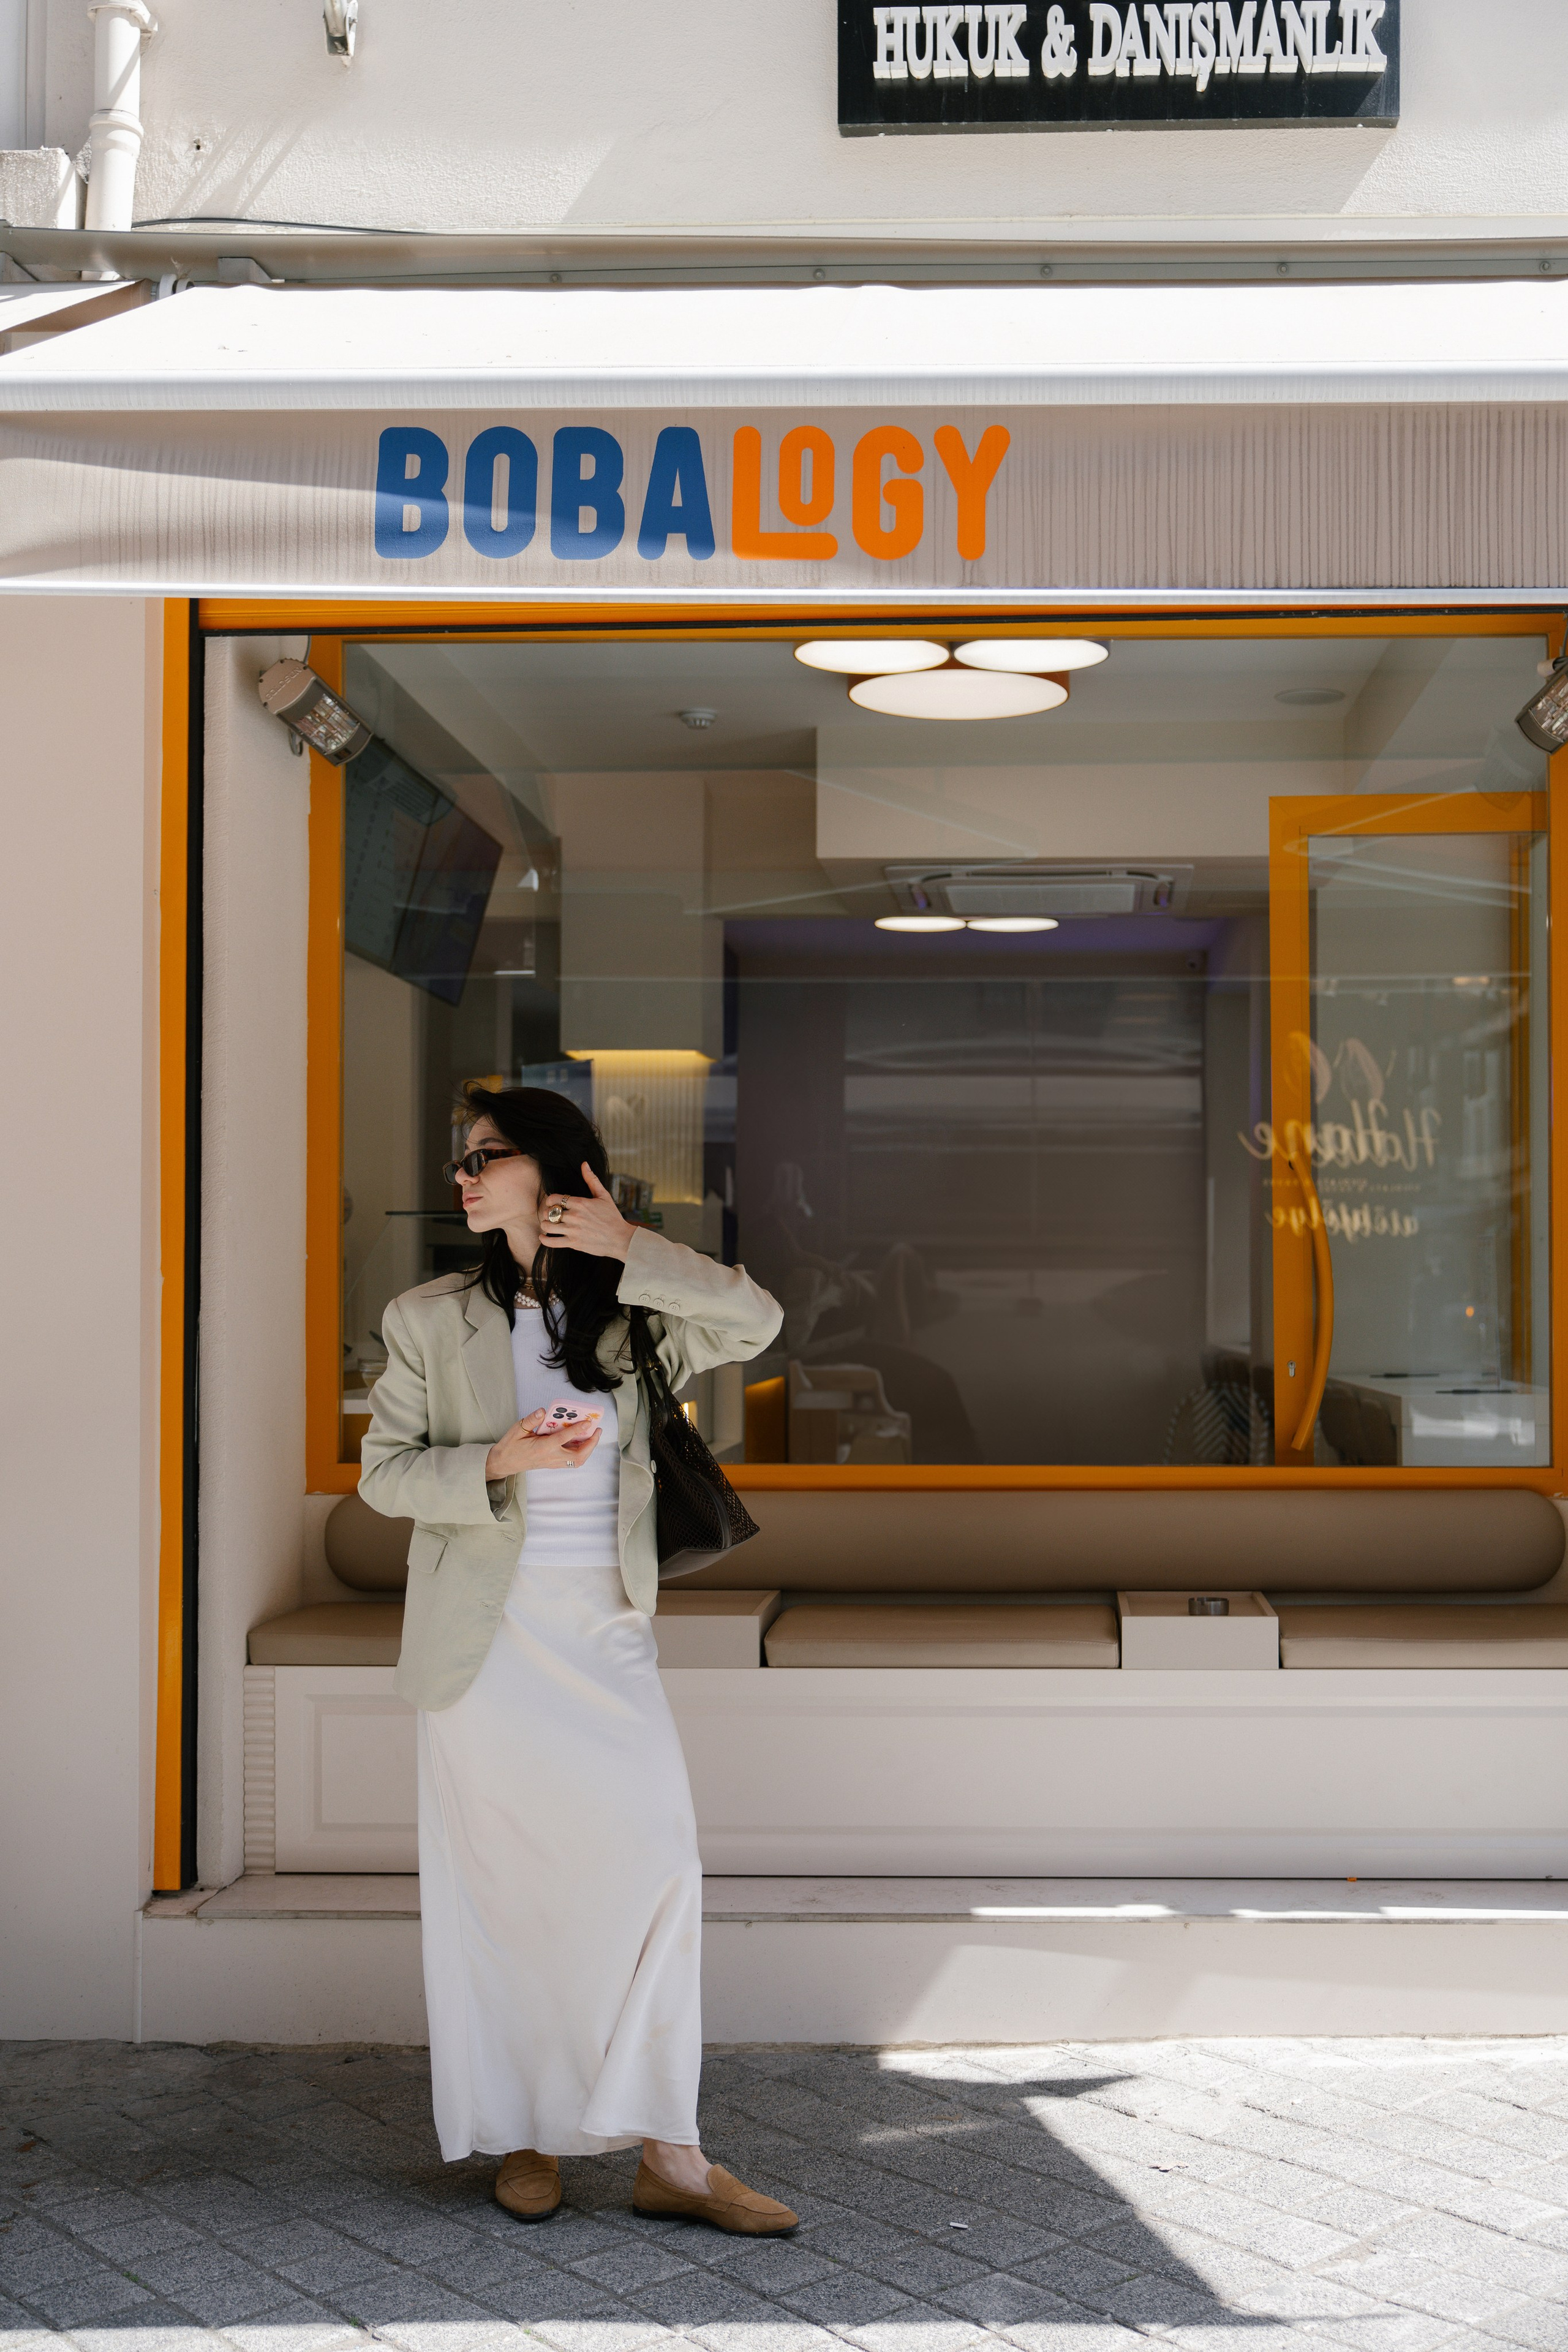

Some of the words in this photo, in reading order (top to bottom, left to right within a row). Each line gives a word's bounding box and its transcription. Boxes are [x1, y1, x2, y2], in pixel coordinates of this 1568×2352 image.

[873, 4, 1030, 79] HUKUK
[1041, 4, 1077, 78] &
[1088, 0, 1387, 92] DANIŞMANLIK
[374, 424, 1011, 560] BOBALOGY
[265, 666, 303, 701] GOLDSUN
